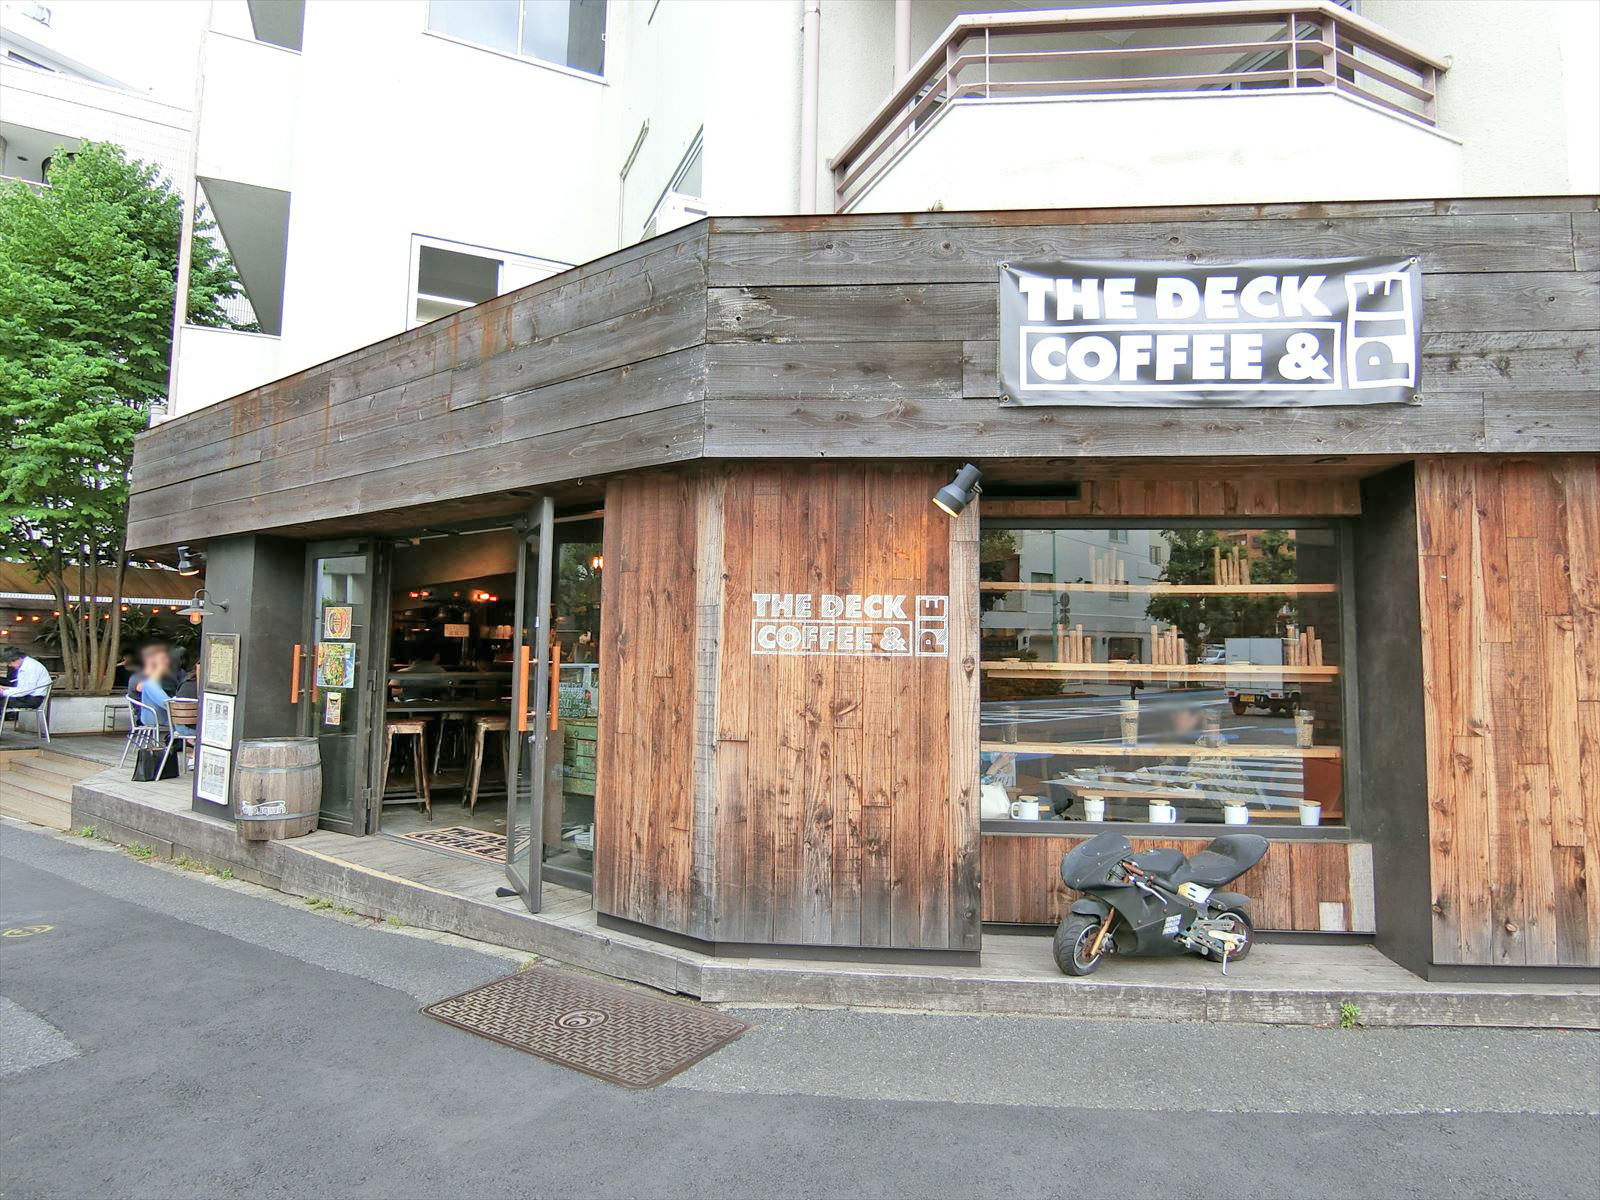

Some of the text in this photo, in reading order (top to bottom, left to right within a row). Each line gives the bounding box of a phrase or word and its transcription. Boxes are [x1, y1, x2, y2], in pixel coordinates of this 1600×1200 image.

[1018, 275, 1332, 321] THE DECK
[1351, 276, 1411, 384] PIE
[1030, 332, 1332, 381] COFFEE &
[752, 593, 908, 619] THE DECK
[917, 597, 946, 655] PIE
[757, 625, 908, 651] COFFEE &
